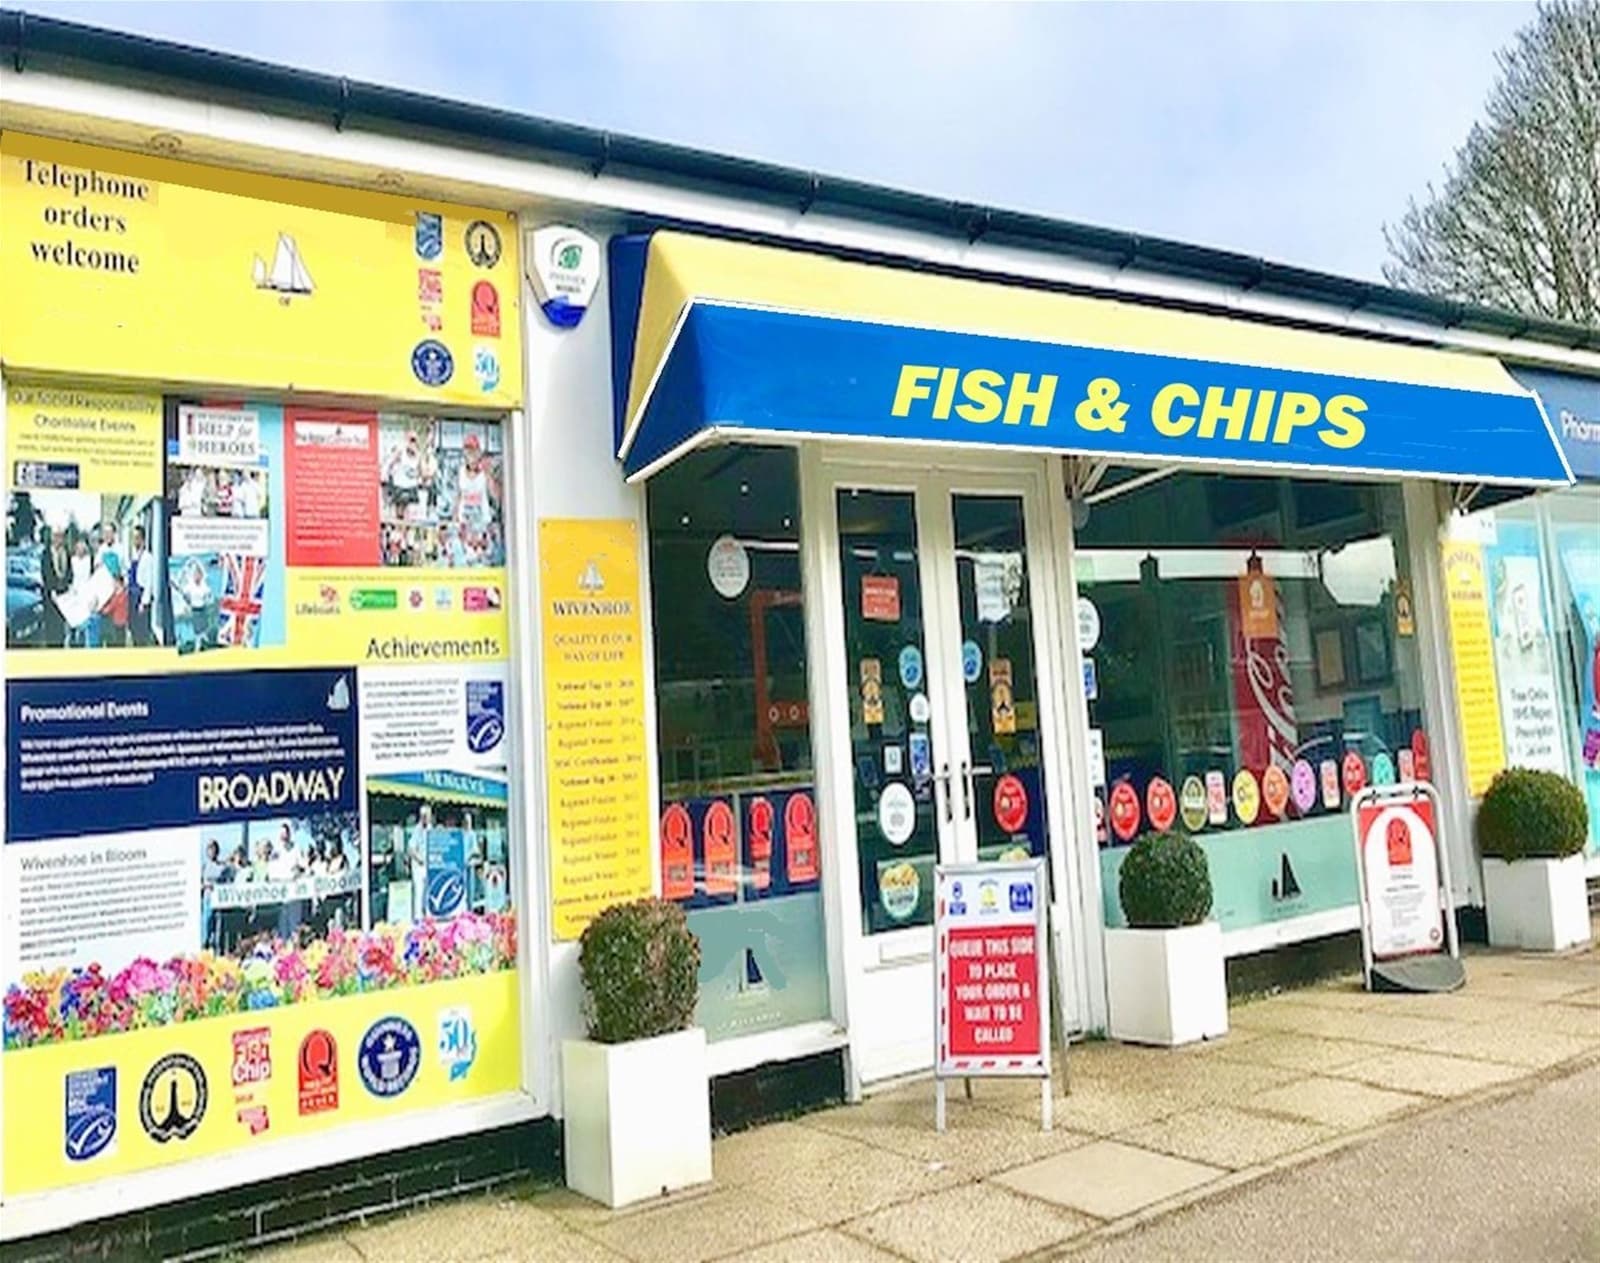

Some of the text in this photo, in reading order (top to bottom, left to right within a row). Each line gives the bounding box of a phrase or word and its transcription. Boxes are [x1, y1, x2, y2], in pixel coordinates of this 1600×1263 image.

[19, 159, 150, 201] Telephone
[44, 205, 127, 233] orders
[31, 239, 140, 274] welcome
[891, 364, 1369, 449] FISH & CHIPS
[34, 415, 136, 433] Charitable Events
[198, 421, 254, 443] HELP for
[197, 440, 256, 457] HEROES
[366, 637, 501, 658] Achievements
[21, 701, 149, 722] Promotional Events
[198, 767, 345, 814] BROADWAY
[21, 848, 148, 871] Wivenhoe in Bloom
[217, 882, 288, 902] Wivenhoe
[294, 881, 308, 896] in
[986, 938, 1010, 955] THIS
[969, 962, 1017, 979] TO PLACE
[956, 985, 984, 1001] YOUR
[985, 984, 1021, 1001] ORDER
[964, 1003, 1023, 1022] WAIT TO BE
[974, 1026, 1014, 1044] CALLED
[233, 1060, 272, 1083] Chip
